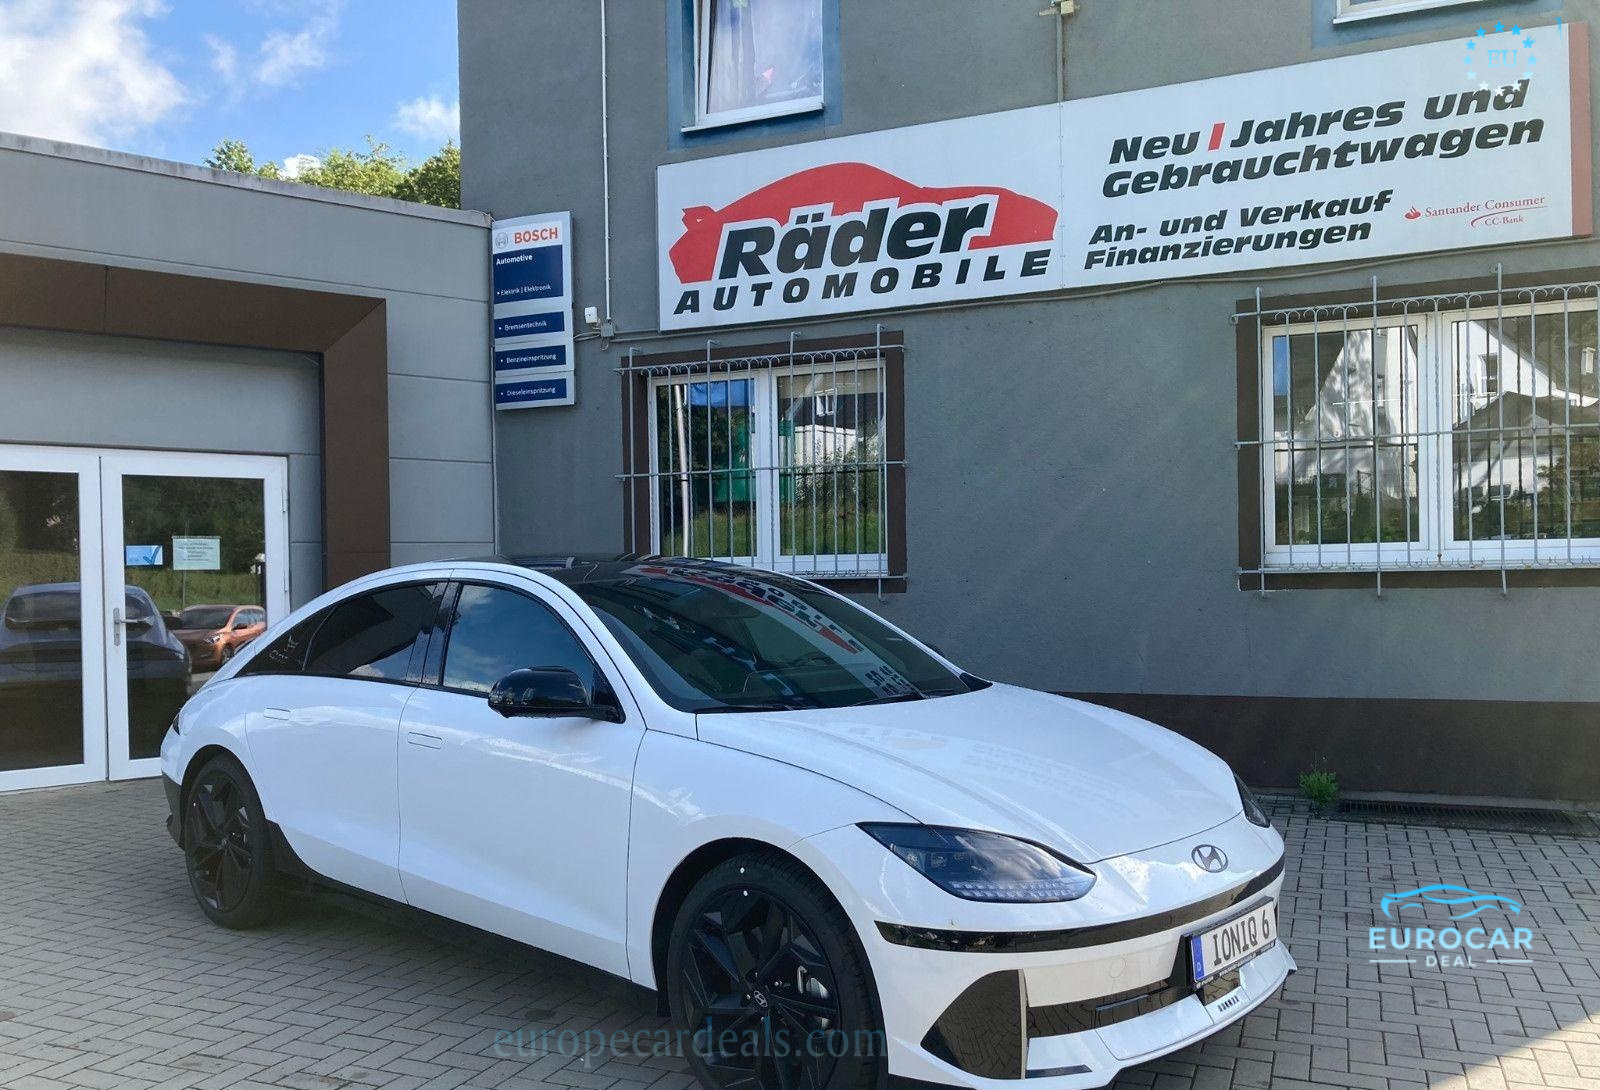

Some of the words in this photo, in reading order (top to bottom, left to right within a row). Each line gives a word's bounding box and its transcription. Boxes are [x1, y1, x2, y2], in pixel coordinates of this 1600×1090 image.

[1109, 131, 1200, 164] Neu
[1229, 101, 1405, 148] Jahres
[1423, 78, 1530, 120] und
[1102, 118, 1544, 198] Gebrauchtwagen
[1088, 223, 1147, 246] An-
[1158, 209, 1226, 237] und
[1239, 189, 1394, 226] Verkauf
[1425, 202, 1481, 218] Santander
[1484, 197, 1545, 211] Consumer
[1484, 215, 1524, 226] CC-Bank
[514, 227, 558, 244] BOSCH
[718, 202, 989, 280] Räder
[1084, 220, 1372, 270] Finanzierungen
[496, 253, 533, 265] Automotive
[500, 286, 520, 295] Elektrik
[524, 284, 551, 293] Elektronik
[673, 248, 1051, 315] AUTOMOBILE
[505, 320, 547, 331] Bremsentechnik
[506, 353, 557, 364] Benzineinspritzung
[507, 386, 556, 397] Dieseleinspritzung
[1213, 915, 1258, 966] IONIQ
[1262, 909, 1270, 940] 6
